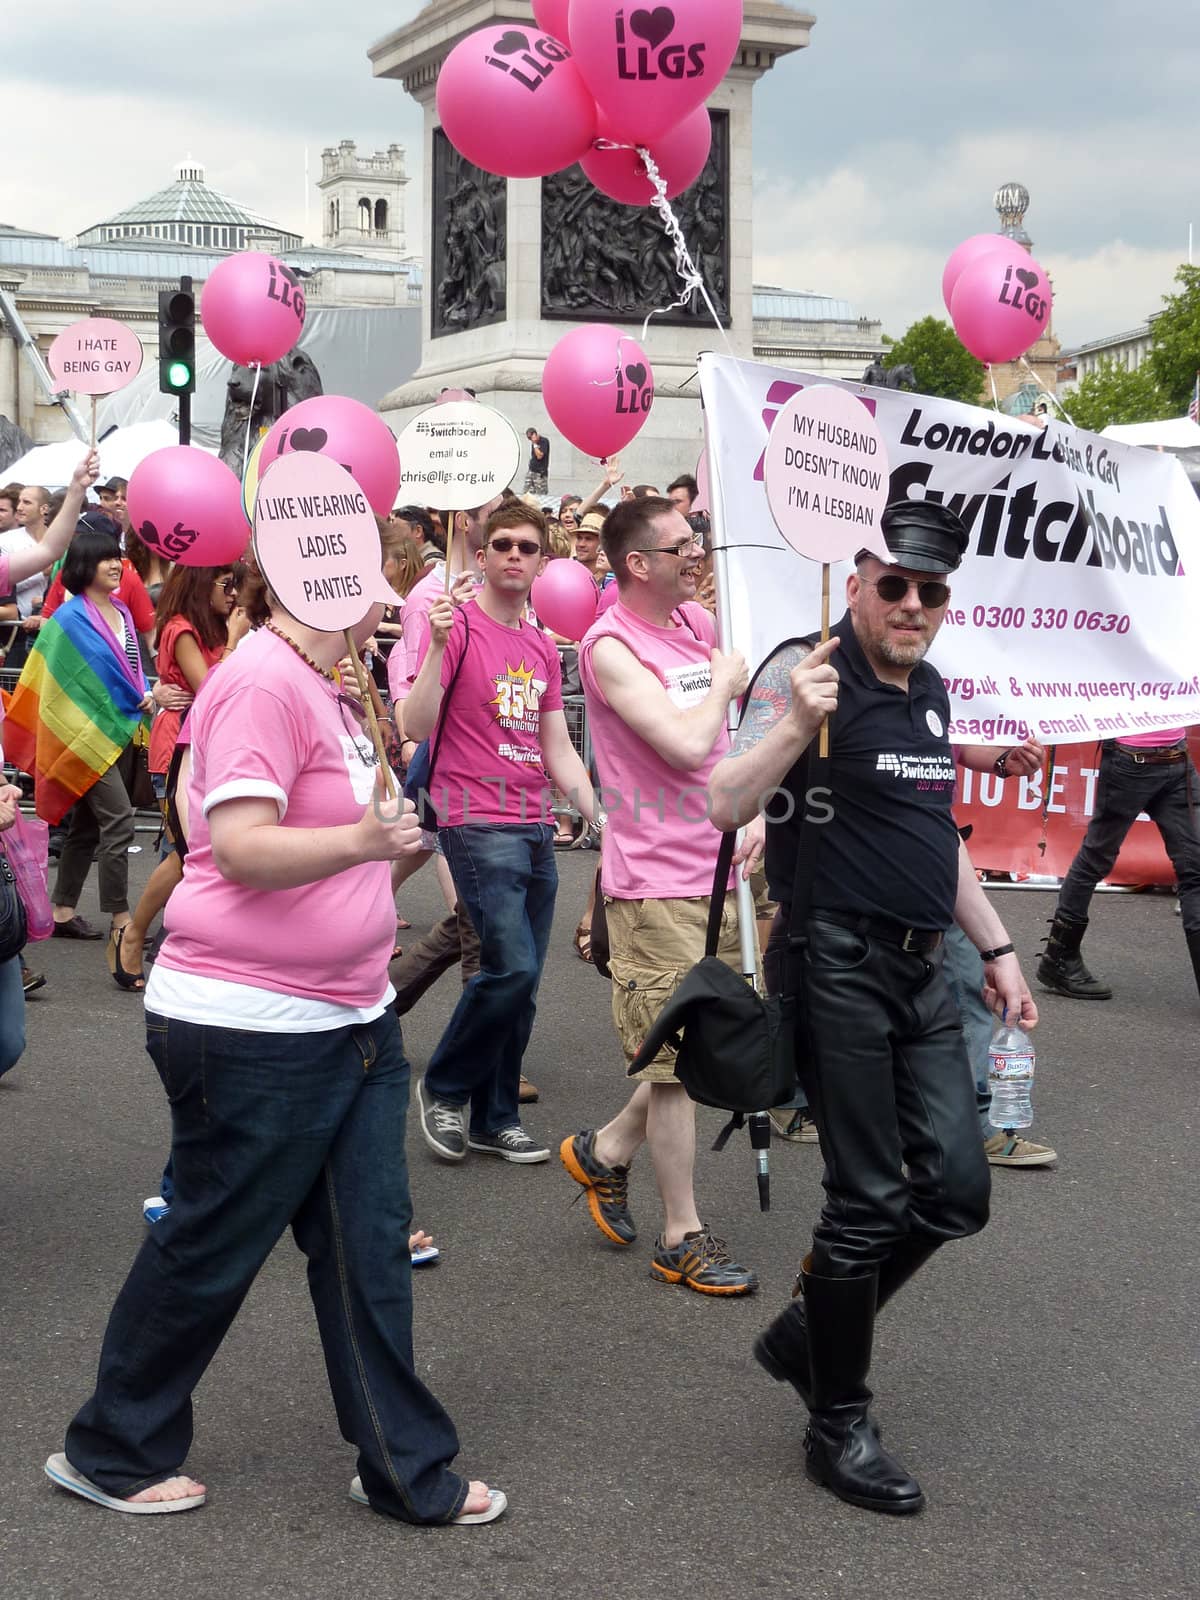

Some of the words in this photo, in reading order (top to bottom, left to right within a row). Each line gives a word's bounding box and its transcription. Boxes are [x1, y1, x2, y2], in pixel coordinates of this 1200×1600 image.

[617, 43, 706, 81] LLGS
[998, 283, 1047, 323] LLGS
[78, 339, 82, 351] I
[85, 339, 118, 351] HATE
[63, 360, 100, 373] BEING
[104, 361, 131, 373] GAY
[615, 387, 655, 414] LLG
[430, 427, 486, 437] Switchboard
[793, 413, 814, 437] MY
[817, 420, 877, 456] HUSBAND
[429, 448, 454, 459] email
[456, 450, 468, 458] us
[900, 408, 1032, 460] London
[1085, 444, 1096, 479] &
[1097, 448, 1121, 494] Gay
[401, 471, 495, 485] chris@llgs.org.uk
[785, 446, 840, 480] DOESN'T
[842, 463, 881, 491] KNOW
[258, 499, 264, 521] I
[265, 497, 298, 521] LIKE
[297, 493, 367, 520] WEARING
[788, 486, 809, 510] I'M
[812, 493, 821, 513] A
[825, 496, 874, 527] LESBIAN
[155, 522, 199, 562] LGS
[297, 533, 347, 559] LADIES
[303, 575, 362, 602] PANTIES
[972, 605, 1025, 629] 0300
[1031, 607, 1068, 630] 330
[1073, 609, 1130, 634] 0630
[497, 682, 525, 719] 35
[1009, 676, 1023, 697] &
[1040, 714, 1091, 735] email
[1097, 713, 1126, 731] and
[1018, 766, 1069, 815] BE
